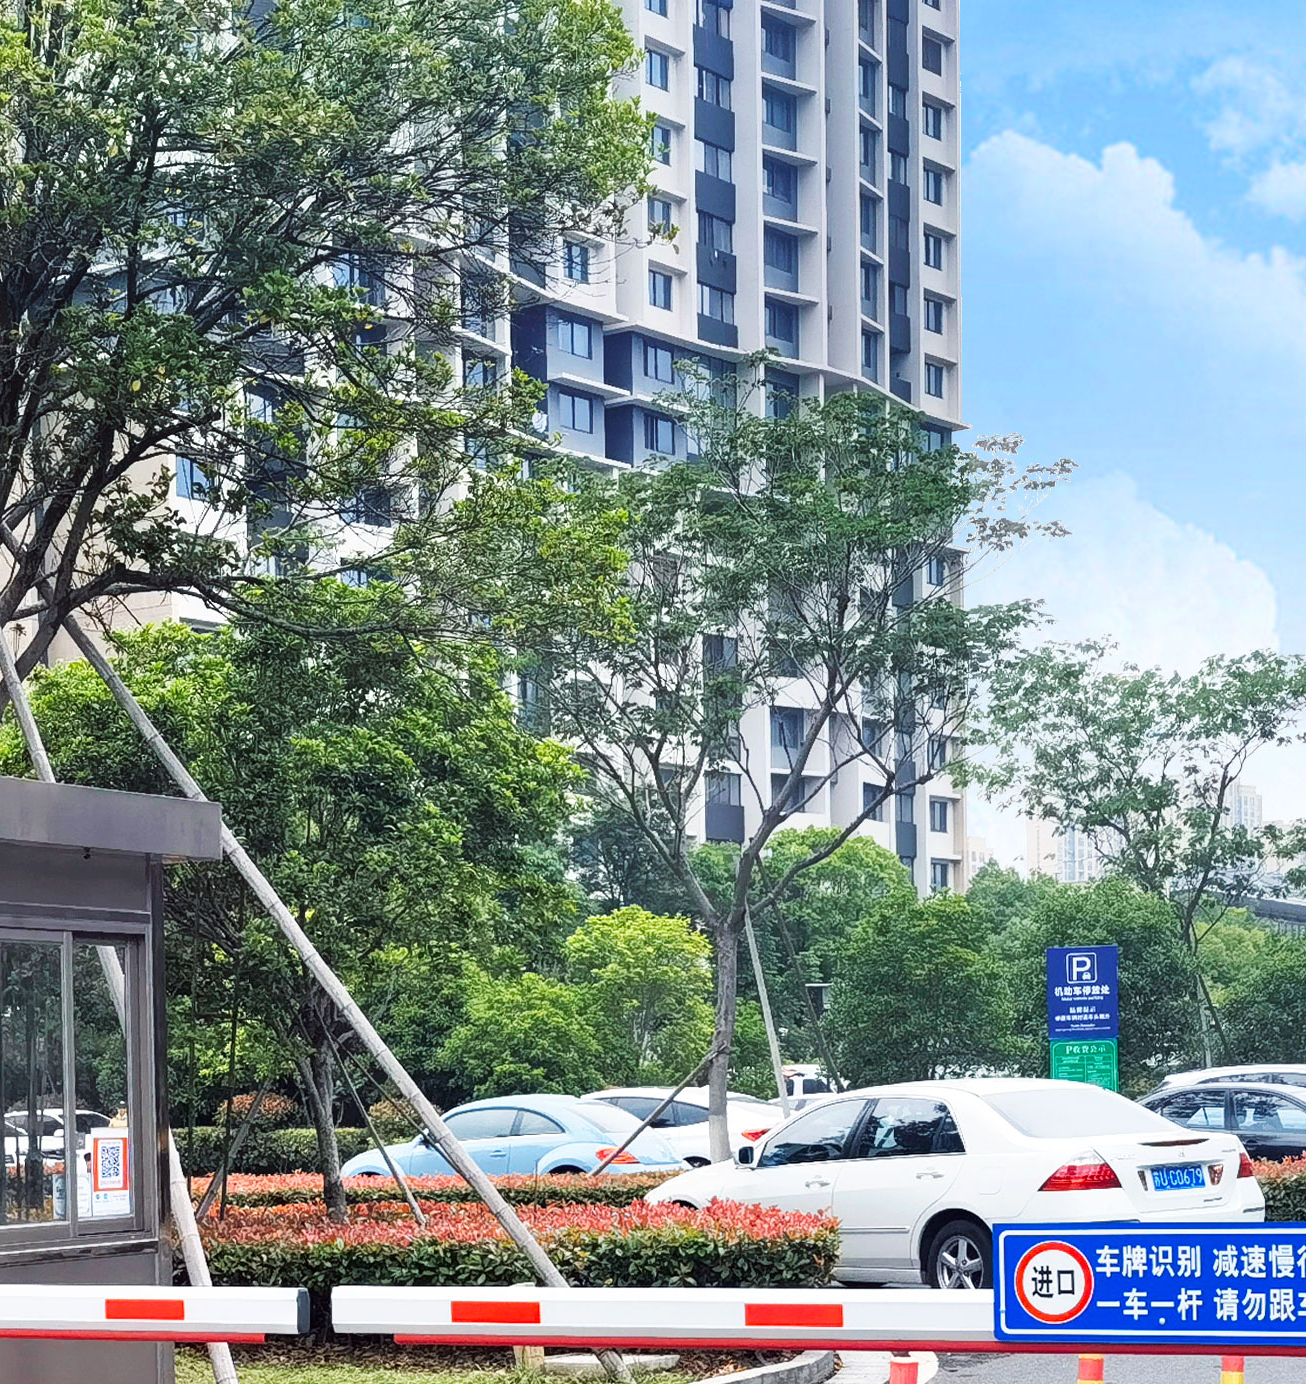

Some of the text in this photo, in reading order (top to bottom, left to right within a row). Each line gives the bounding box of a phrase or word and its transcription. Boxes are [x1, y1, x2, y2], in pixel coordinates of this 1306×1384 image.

[1072, 956, 1091, 981] P
[1095, 1244, 1201, 1279] 车牌识别
[1031, 1265, 1076, 1299] 进口
[1096, 1287, 1203, 1322] 一车一杆
